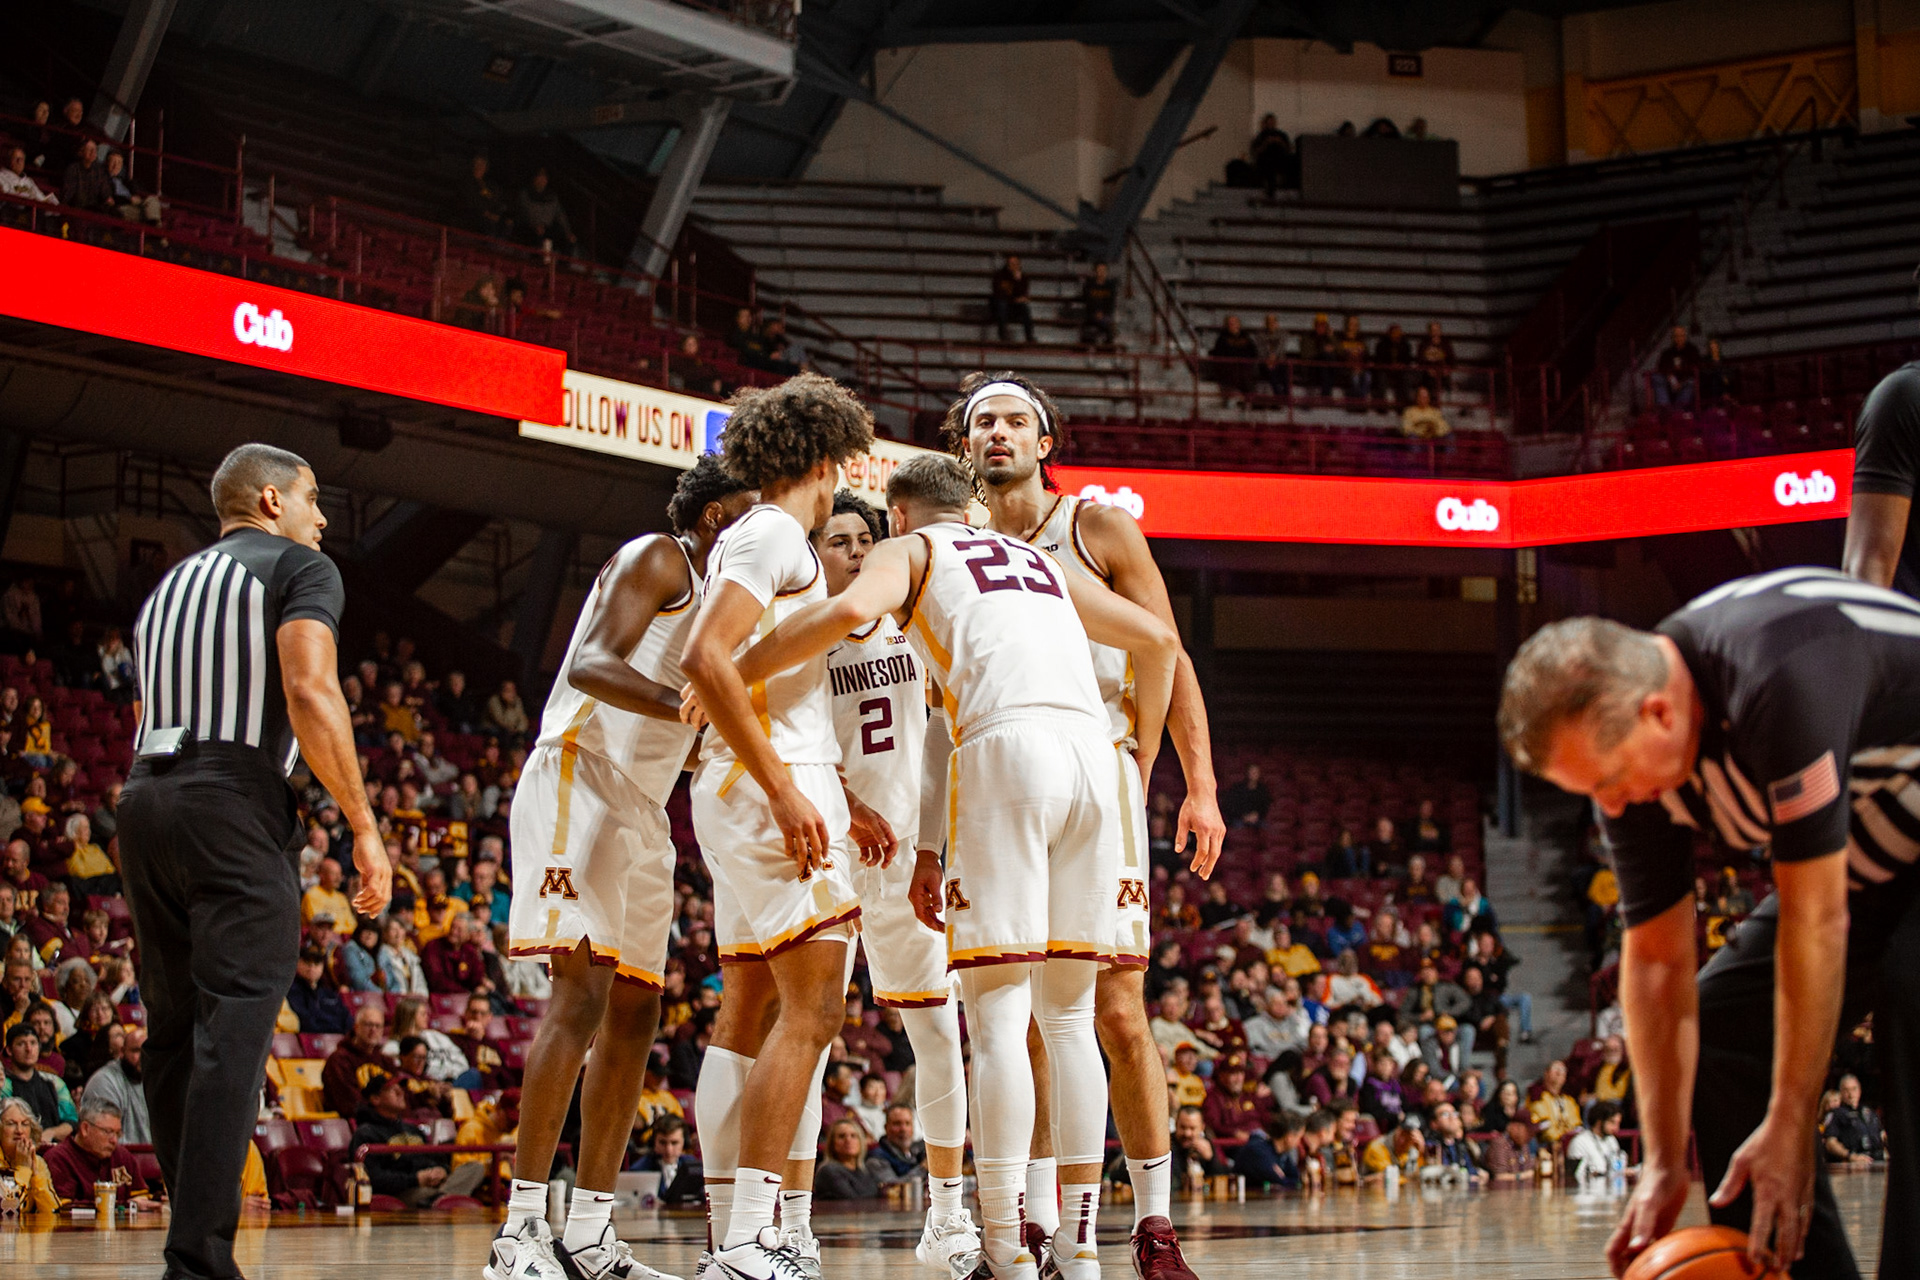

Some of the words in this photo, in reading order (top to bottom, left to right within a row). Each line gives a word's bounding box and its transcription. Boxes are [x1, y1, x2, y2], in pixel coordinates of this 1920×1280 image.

[233, 302, 295, 353] Cub
[564, 388, 630, 439] OLLOW
[638, 404, 663, 447] US
[670, 411, 695, 453] ON
[1774, 469, 1836, 508] Cub
[1436, 497, 1499, 532] Cub
[952, 538, 1064, 600] 23
[859, 696, 895, 755] 2
[539, 867, 579, 900] M
[1116, 877, 1149, 912] M
